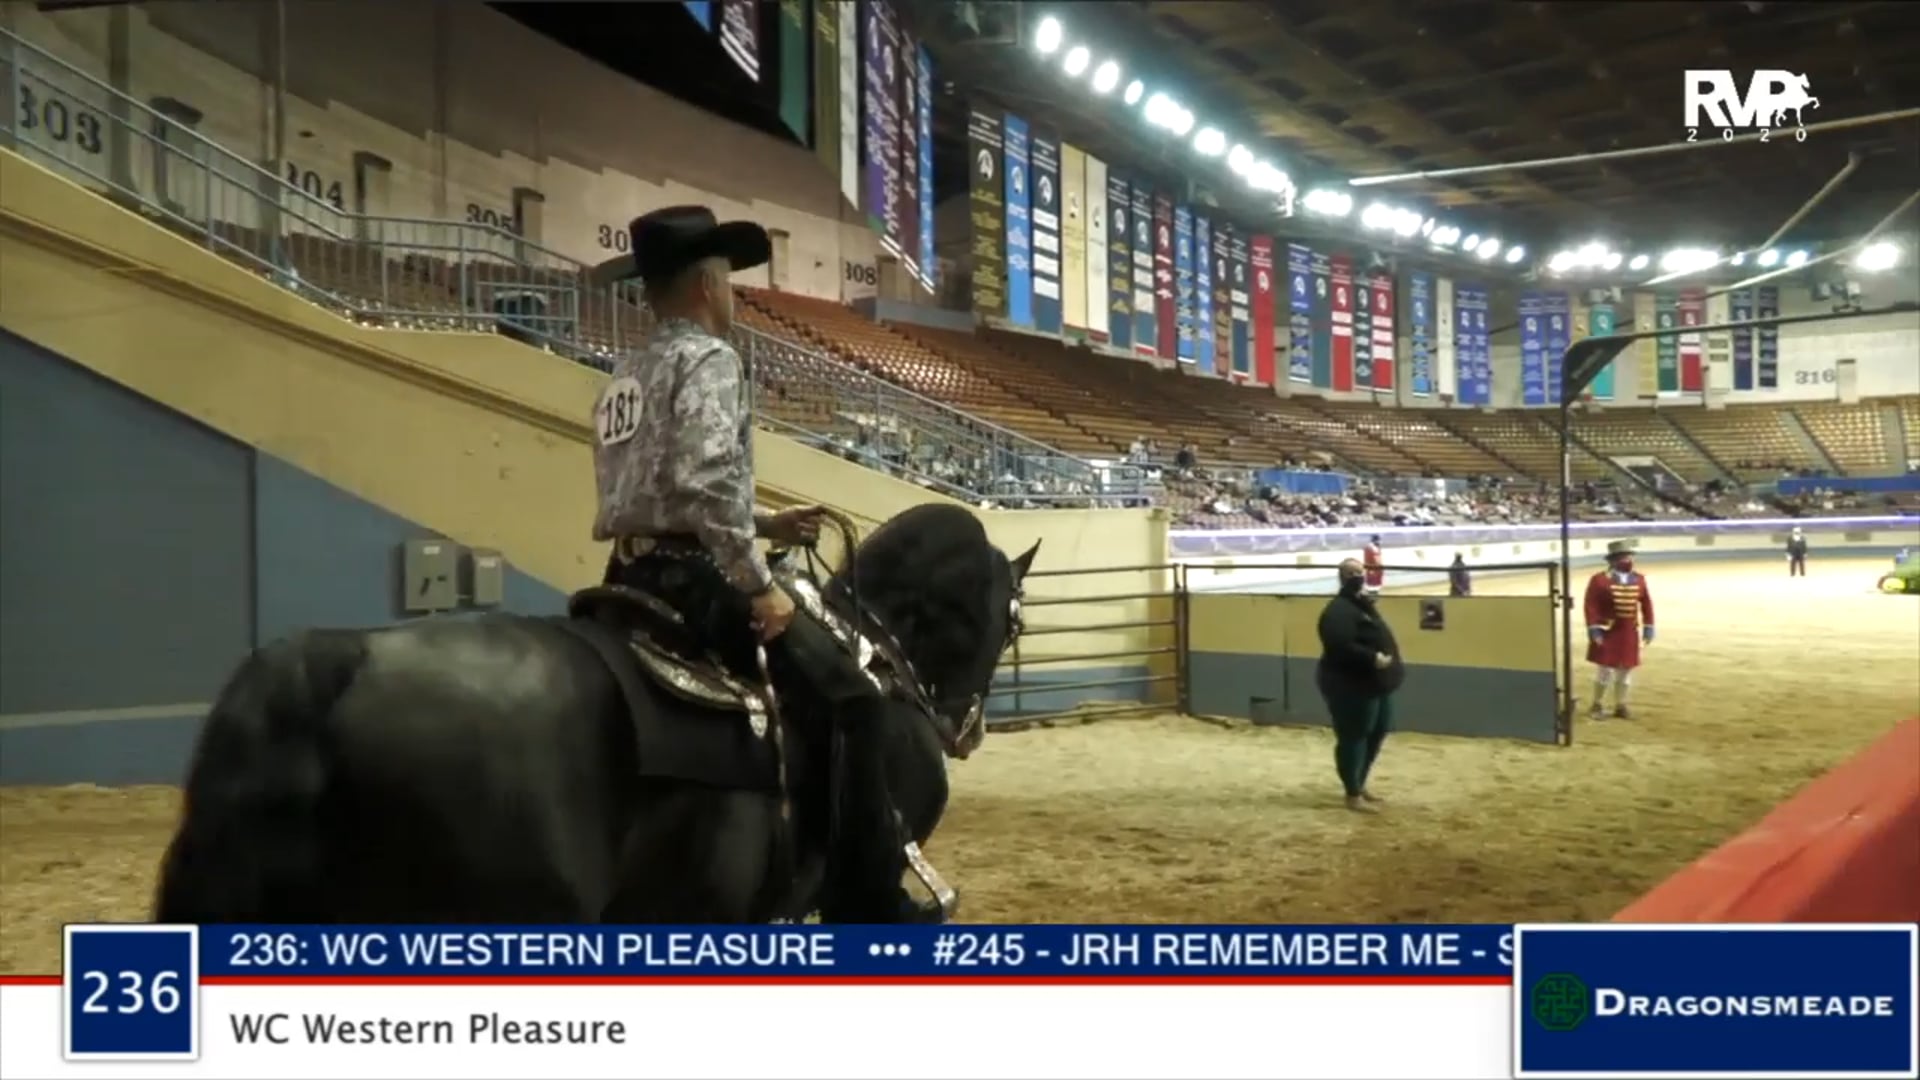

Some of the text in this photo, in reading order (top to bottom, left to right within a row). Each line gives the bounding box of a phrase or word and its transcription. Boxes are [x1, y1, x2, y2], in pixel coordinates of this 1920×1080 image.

[598, 224, 629, 252] 30
[1794, 368, 1836, 385] 316
[603, 388, 636, 440] 181
